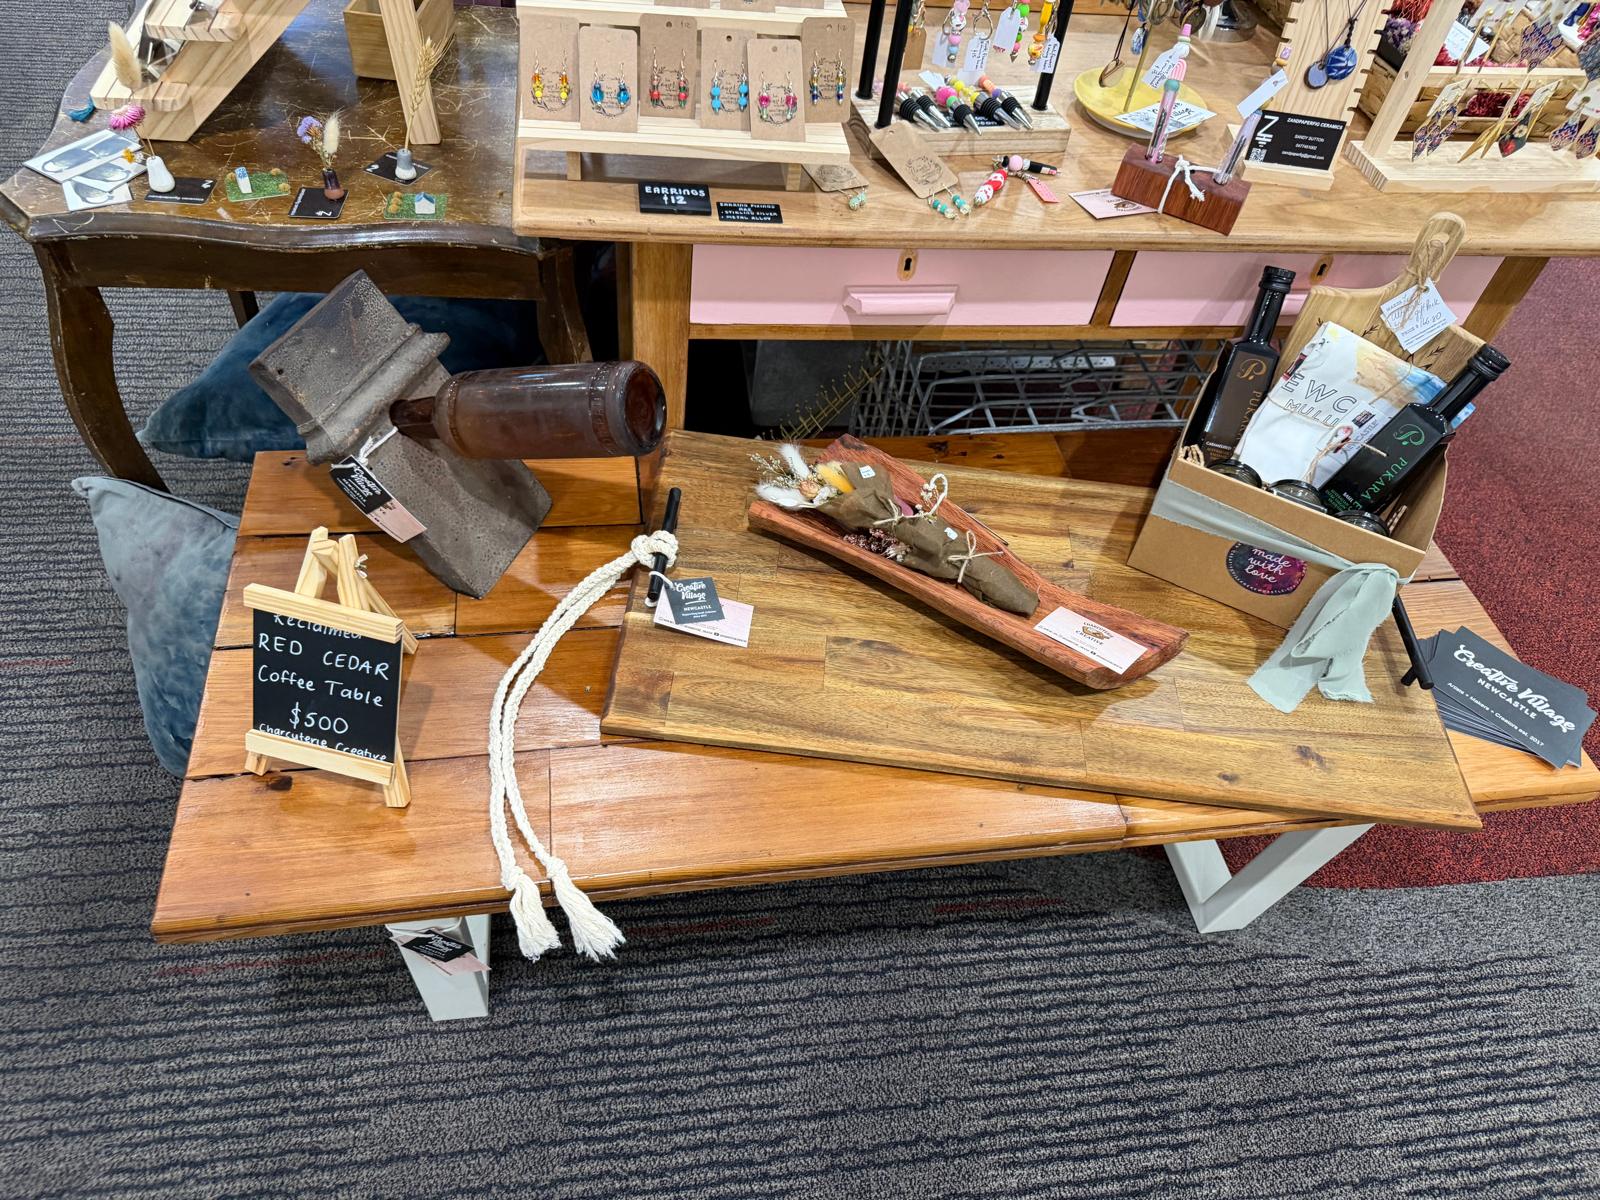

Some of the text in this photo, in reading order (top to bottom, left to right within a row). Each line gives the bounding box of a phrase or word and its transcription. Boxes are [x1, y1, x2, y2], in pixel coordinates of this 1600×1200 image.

[1320, 122, 1344, 130] CERAMICS
[644, 185, 706, 197] EARRINGS
[662, 194, 688, 205] $12
[350, 474, 373, 498] Village
[353, 464, 382, 496] Creative
[1361, 456, 1409, 500] PUKARA
[1247, 556, 1286, 576] with
[1252, 547, 1292, 568] made
[1244, 564, 1277, 583] love
[674, 581, 707, 592] Creative
[681, 591, 706, 601] Village
[683, 604, 712, 612] NEWCASTLE
[258, 632, 390, 681] RED CEDAR
[257, 664, 384, 708] Coffee Table
[1453, 643, 1576, 734] Creative Village
[1477, 677, 1538, 720] NEWCASTLE
[288, 701, 349, 734] $500
[1469, 695, 1490, 711] Makers
[1529, 735, 1545, 747] 2017
[259, 723, 387, 761] Charcuterie Creative
